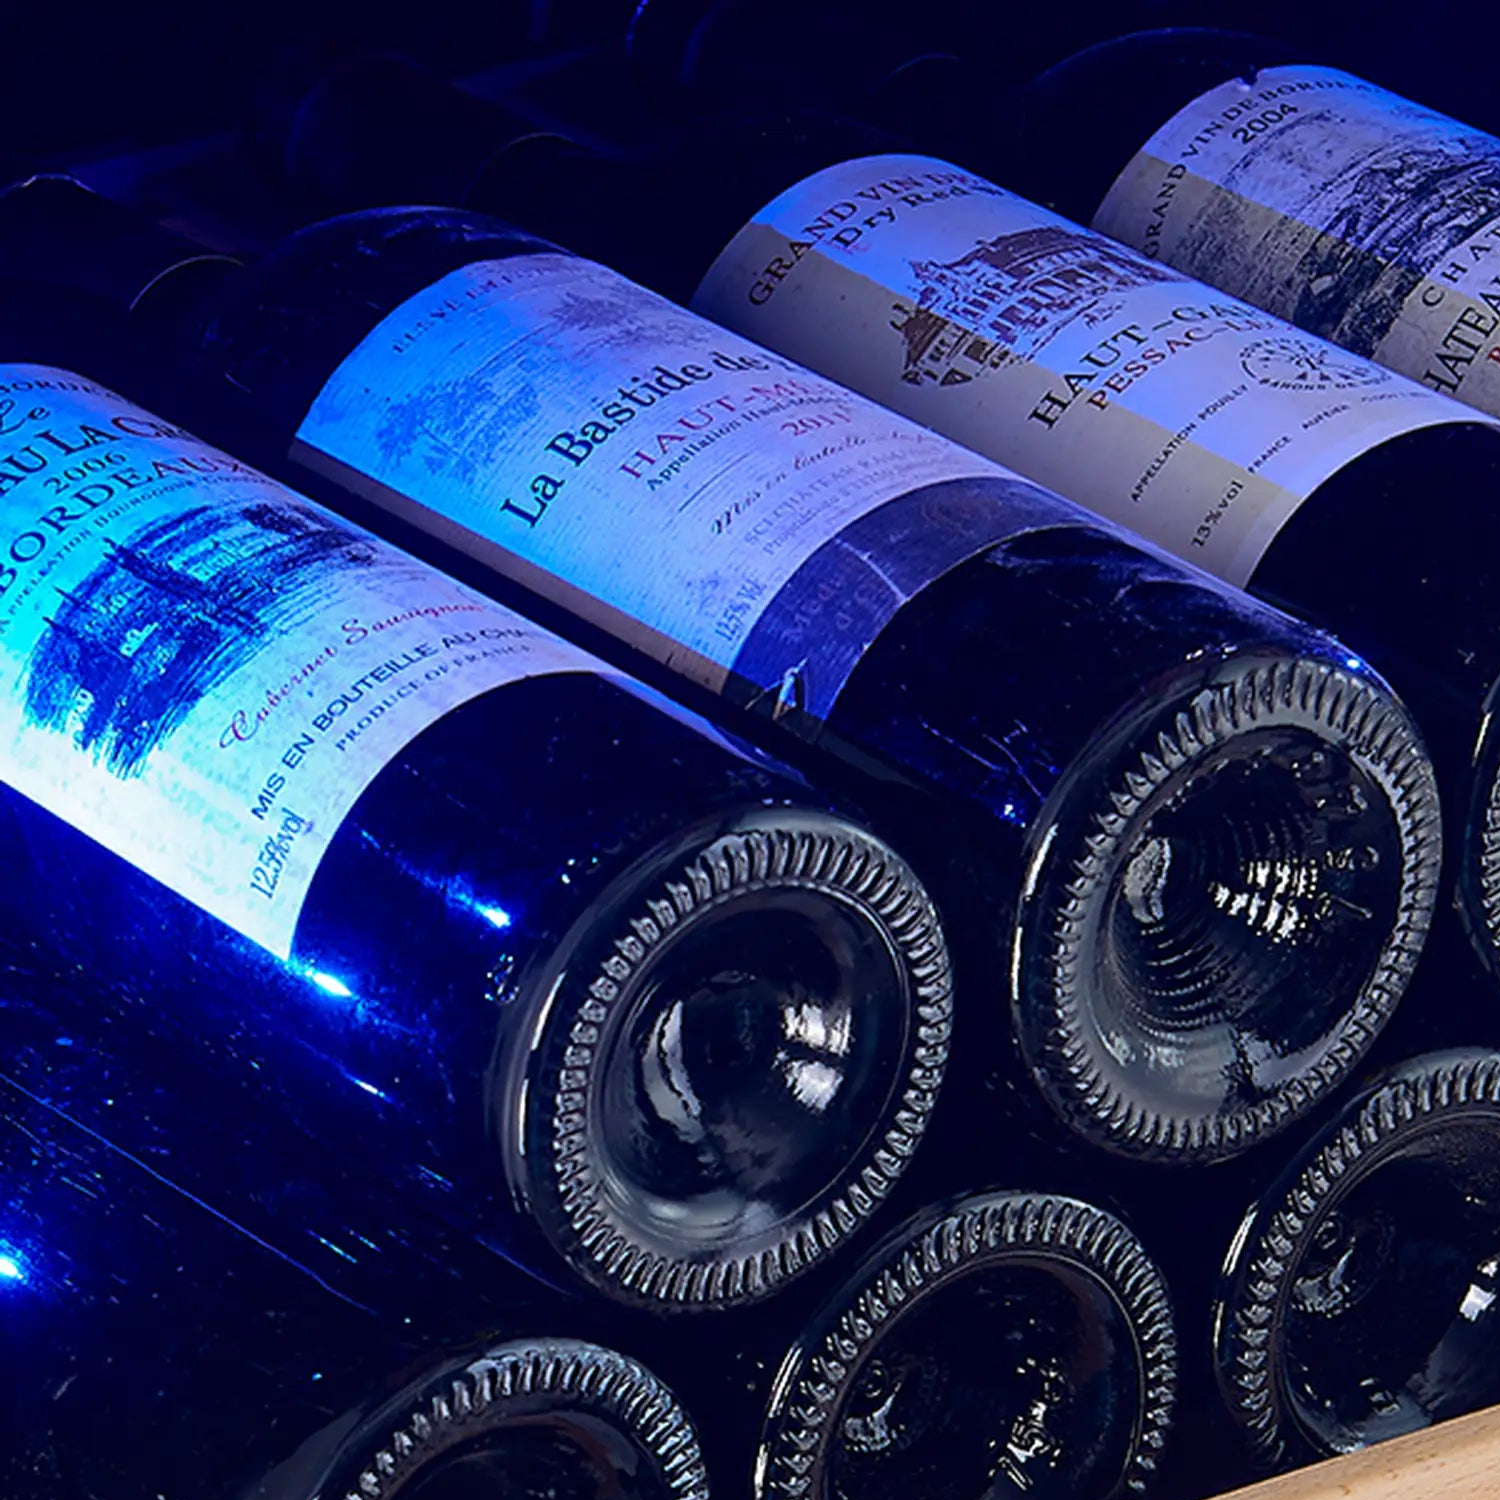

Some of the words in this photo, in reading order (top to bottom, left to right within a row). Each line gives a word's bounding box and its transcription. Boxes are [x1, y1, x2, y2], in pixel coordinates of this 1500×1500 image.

[1181, 121, 1224, 159] VIN
[1222, 97, 1259, 121] DE
[1232, 102, 1299, 144] 2004
[748, 201, 858, 305] GRAND
[831, 206, 896, 250] Dry
[42, 450, 127, 496] 2006
[500, 472, 565, 527] La
[545, 364, 714, 467] Bastide
[645, 424, 743, 491] Appellation
[1130, 422, 1197, 503] APPELLATION
[1191, 480, 1244, 549] 13%vol
[219, 645, 338, 749] Cabernet
[250, 771, 286, 821] MIS
[281, 732, 315, 770] EN
[312, 641, 438, 733] BOUTEILLE
[441, 632, 476, 649] AU
[335, 682, 421, 752] PRODUCE
[424, 664, 449, 682] OF
